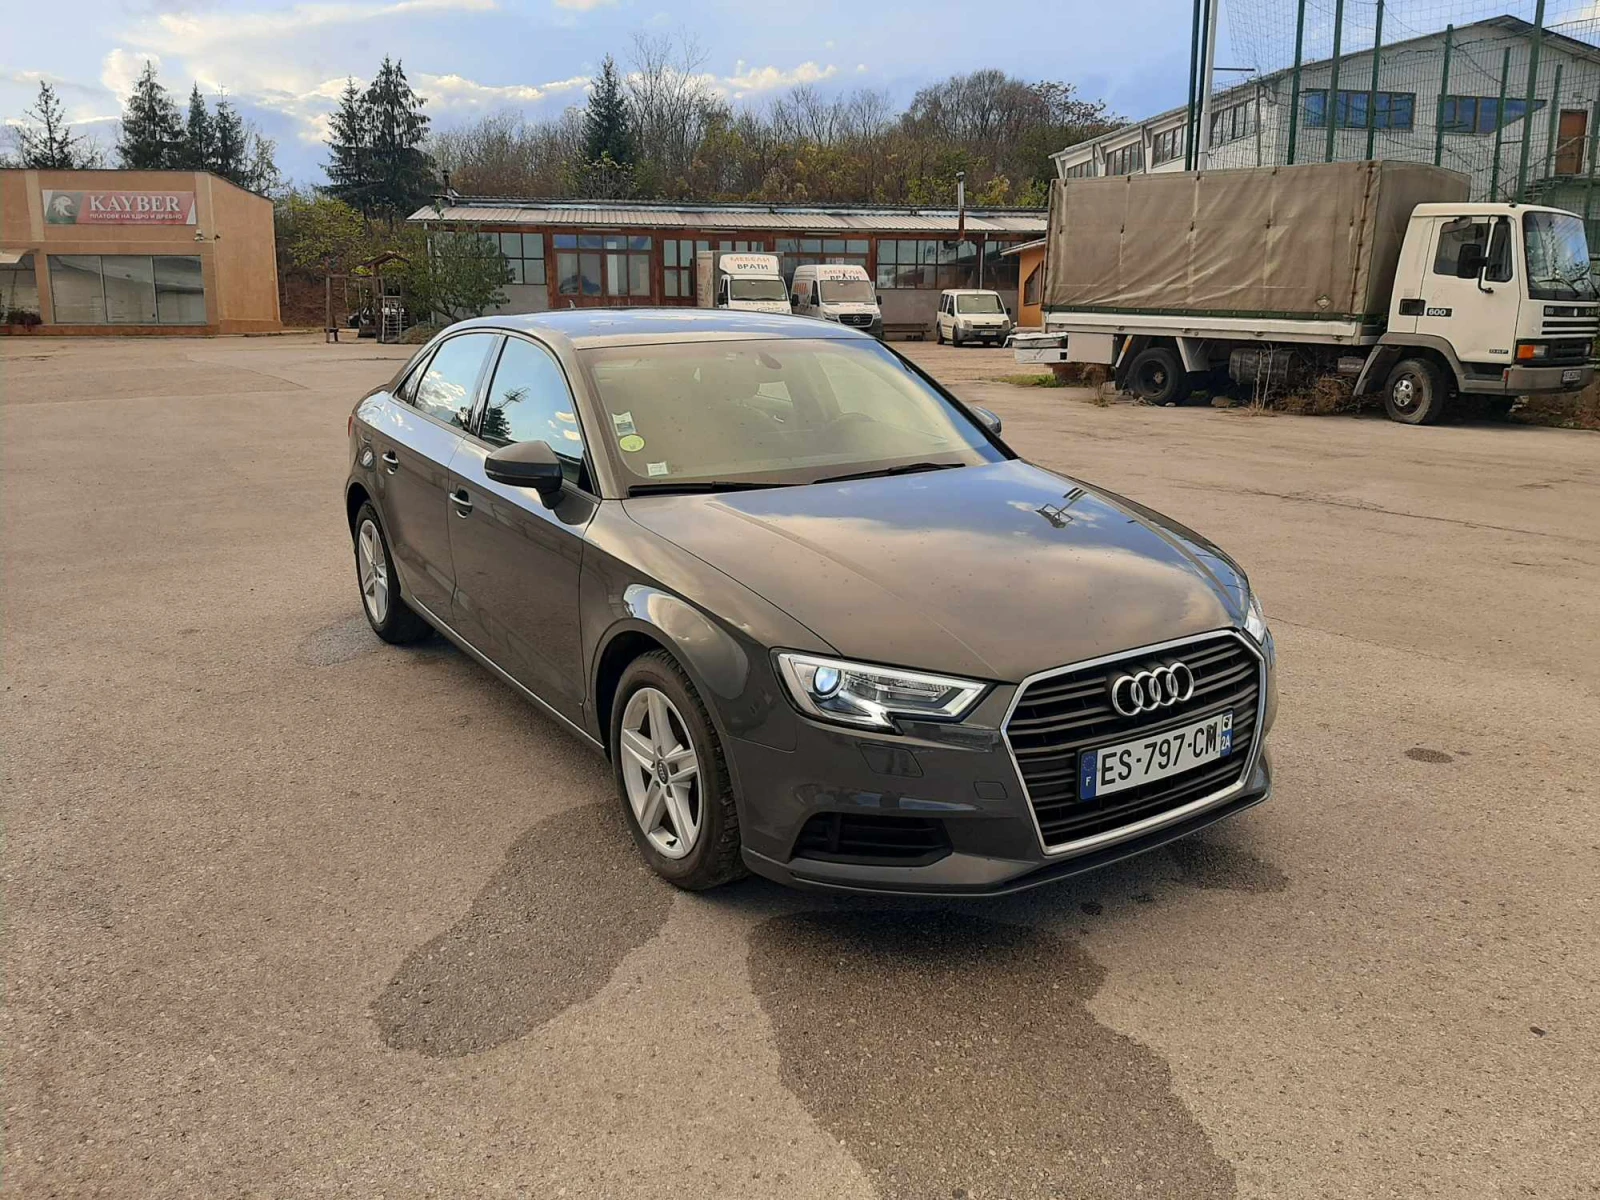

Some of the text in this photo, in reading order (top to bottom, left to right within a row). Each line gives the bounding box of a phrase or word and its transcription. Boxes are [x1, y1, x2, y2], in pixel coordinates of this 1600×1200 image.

[89, 195, 180, 212] KAYBER
[1428, 308, 1447, 316] 600
[1220, 735, 1231, 751] 2A
[1085, 776, 1092, 786] F
